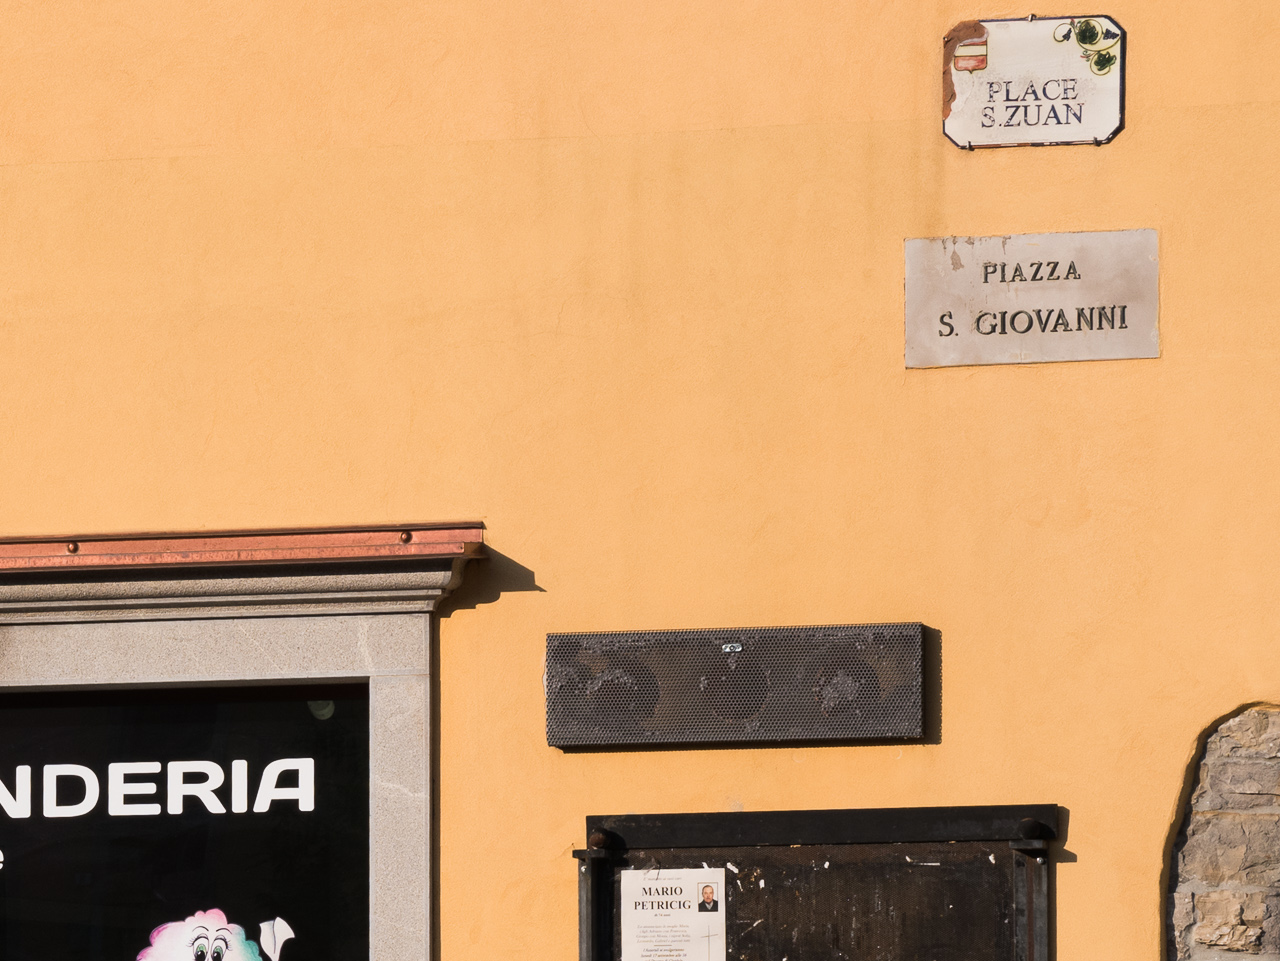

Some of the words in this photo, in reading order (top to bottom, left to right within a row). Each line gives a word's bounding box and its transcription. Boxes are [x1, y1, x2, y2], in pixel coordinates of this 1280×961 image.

[986, 78, 1079, 103] PLACE
[981, 102, 1084, 129] S.ZUAN
[982, 260, 1082, 284] PIAZZA
[938, 311, 959, 337] S.
[975, 305, 1128, 335] GIOVANNI
[642, 886, 683, 896] MARIO
[634, 900, 691, 910] PETRICIG
